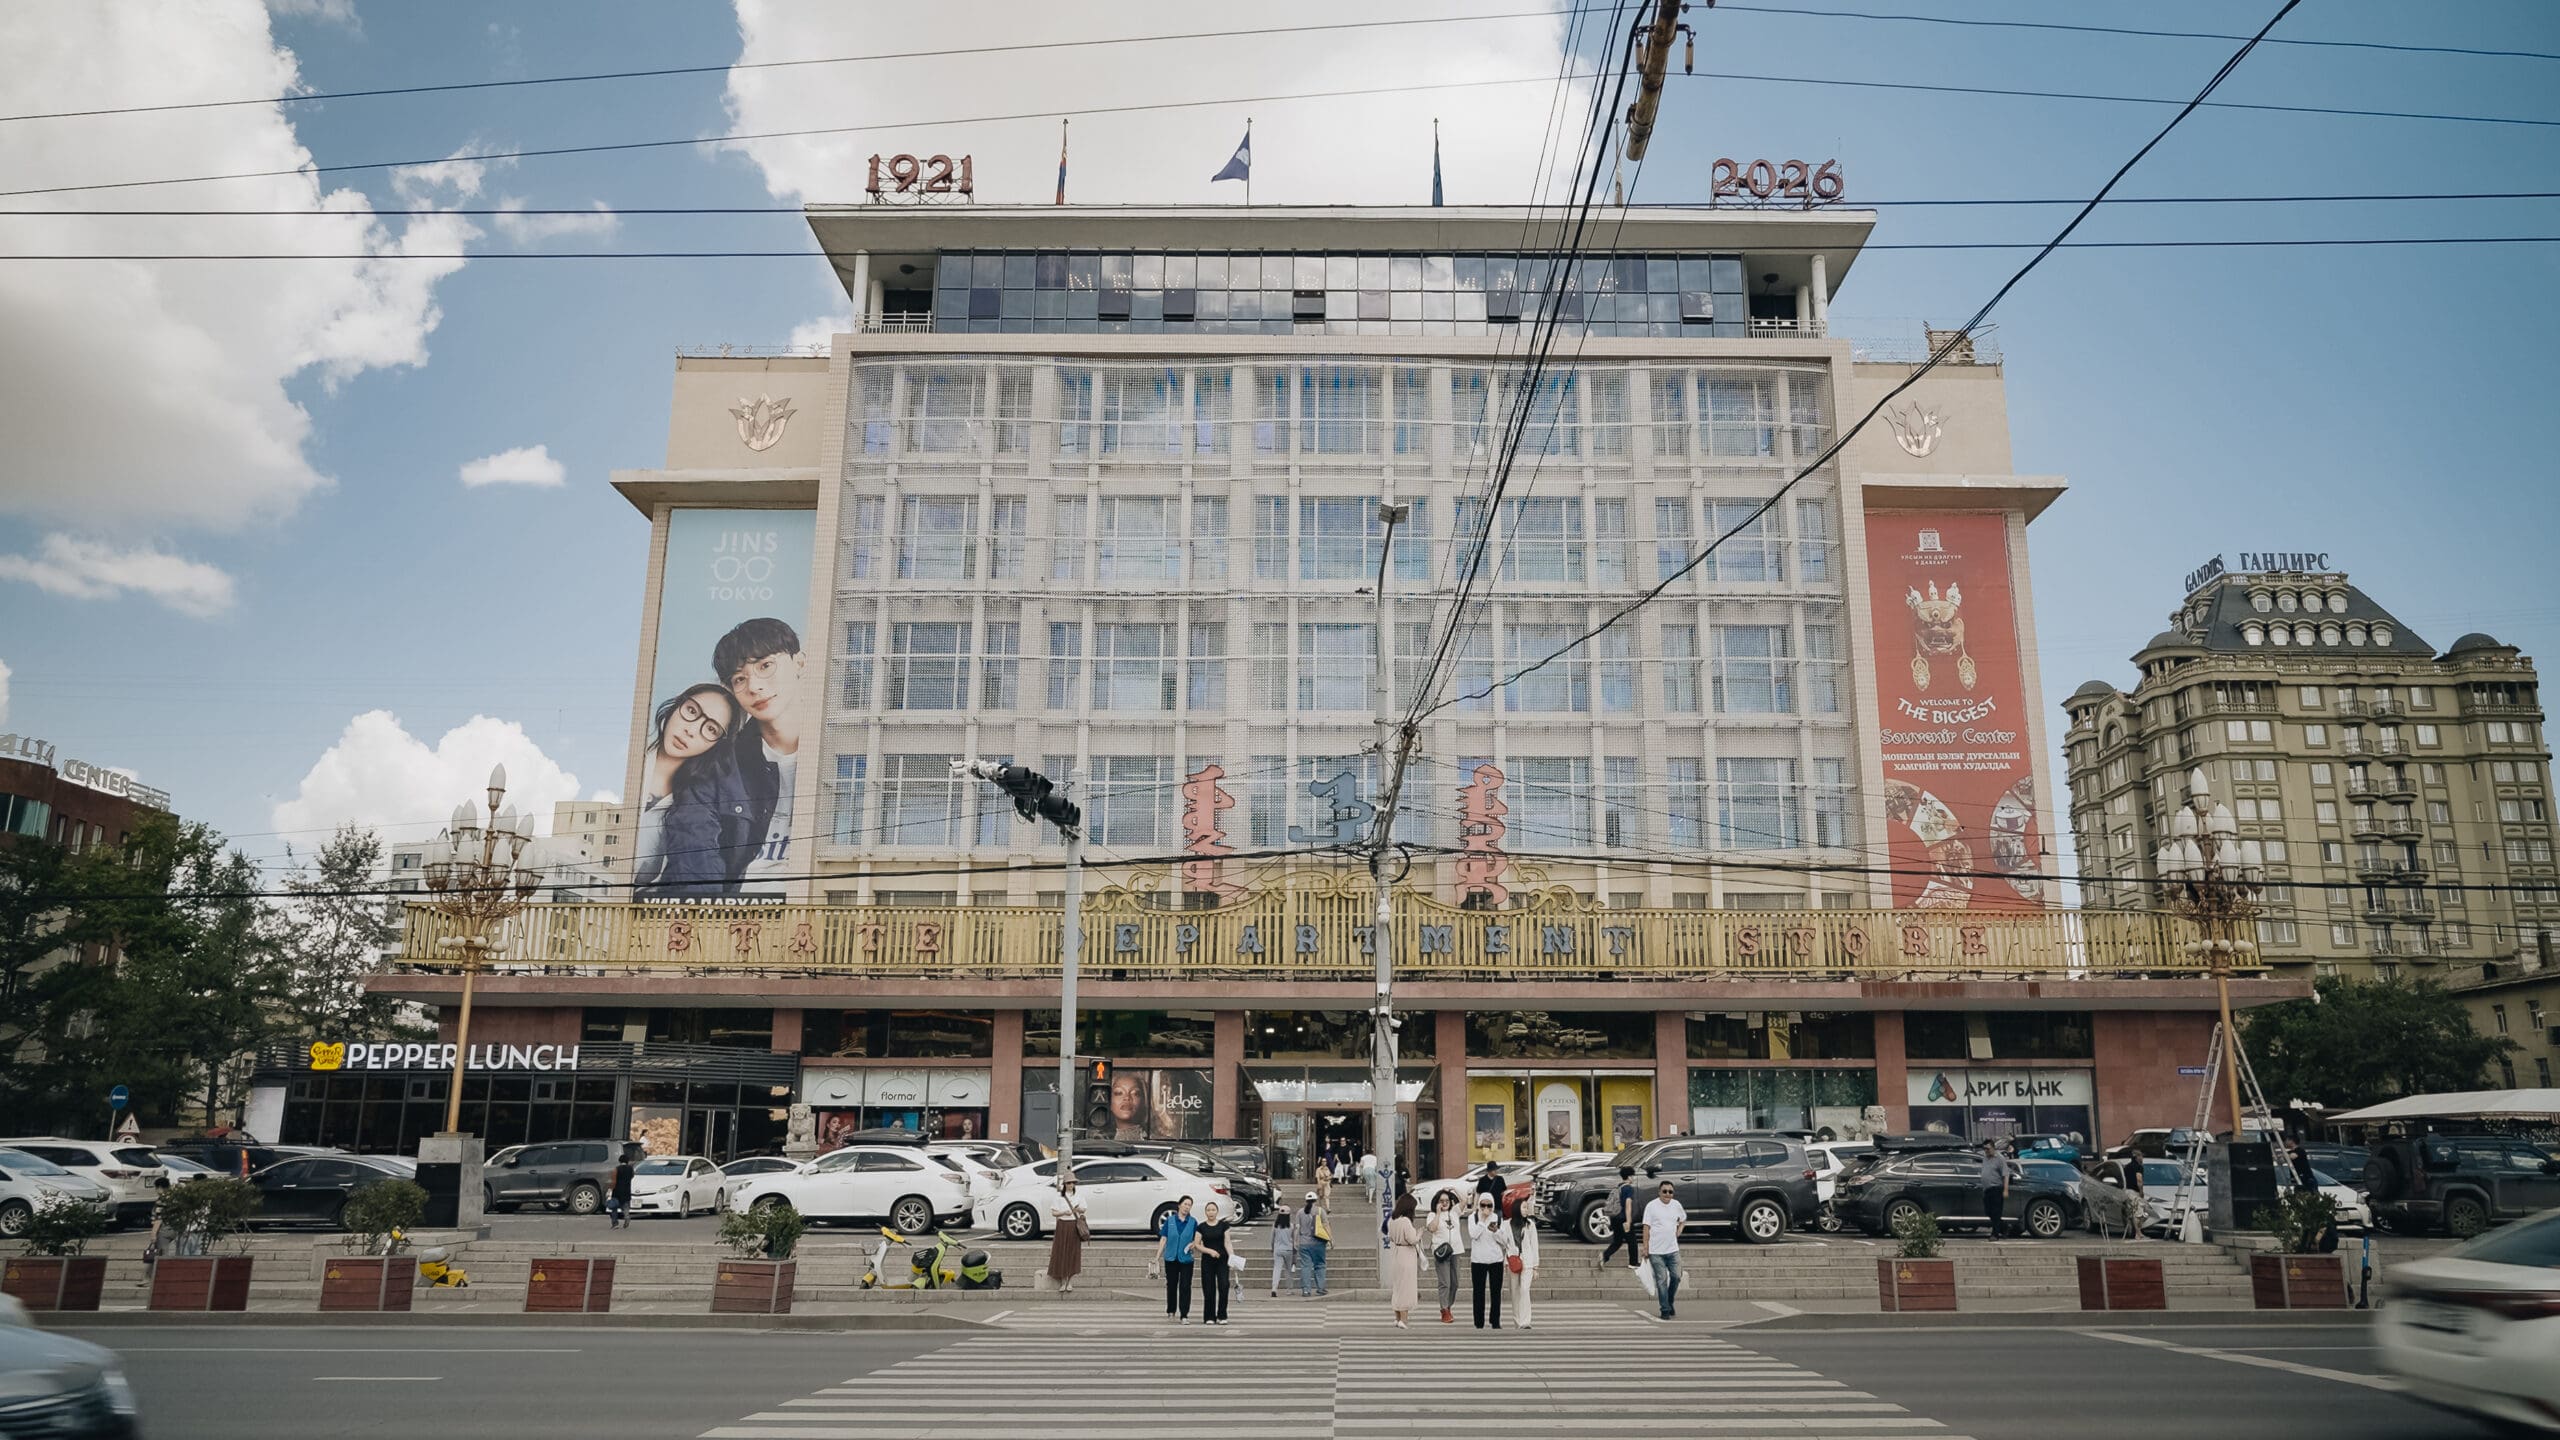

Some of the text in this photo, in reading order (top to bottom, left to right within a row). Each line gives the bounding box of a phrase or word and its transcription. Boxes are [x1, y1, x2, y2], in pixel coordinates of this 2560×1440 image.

[866, 154, 973, 193] 1921
[1712, 158, 1844, 198] 2026
[1069, 273, 1183, 293] NEW
[711, 531, 779, 552] JINS
[2240, 552, 2330, 571] ГАНДИРС
[709, 586, 774, 600] TOKYO
[1897, 696, 1997, 724] THE BIGGEST
[1962, 698, 1973, 706] TO
[1880, 728, 2017, 745] Souvenir Center
[1882, 753, 1935, 761] МОНГОЛЫН
[1937, 752, 1964, 760] БЭЛЭГ
[1893, 762, 2011, 771] ХАМГИЙН ТОМ ХУДАЛДАА
[64, 758, 131, 796] CENTER
[667, 922, 941, 952] STATE
[1737, 926, 1989, 956] STORE
[346, 1043, 579, 1070] PEPPER LUNCH
[881, 1091, 917, 1100] flormar
[1964, 1080, 2063, 1097] АРИГ БАНК
